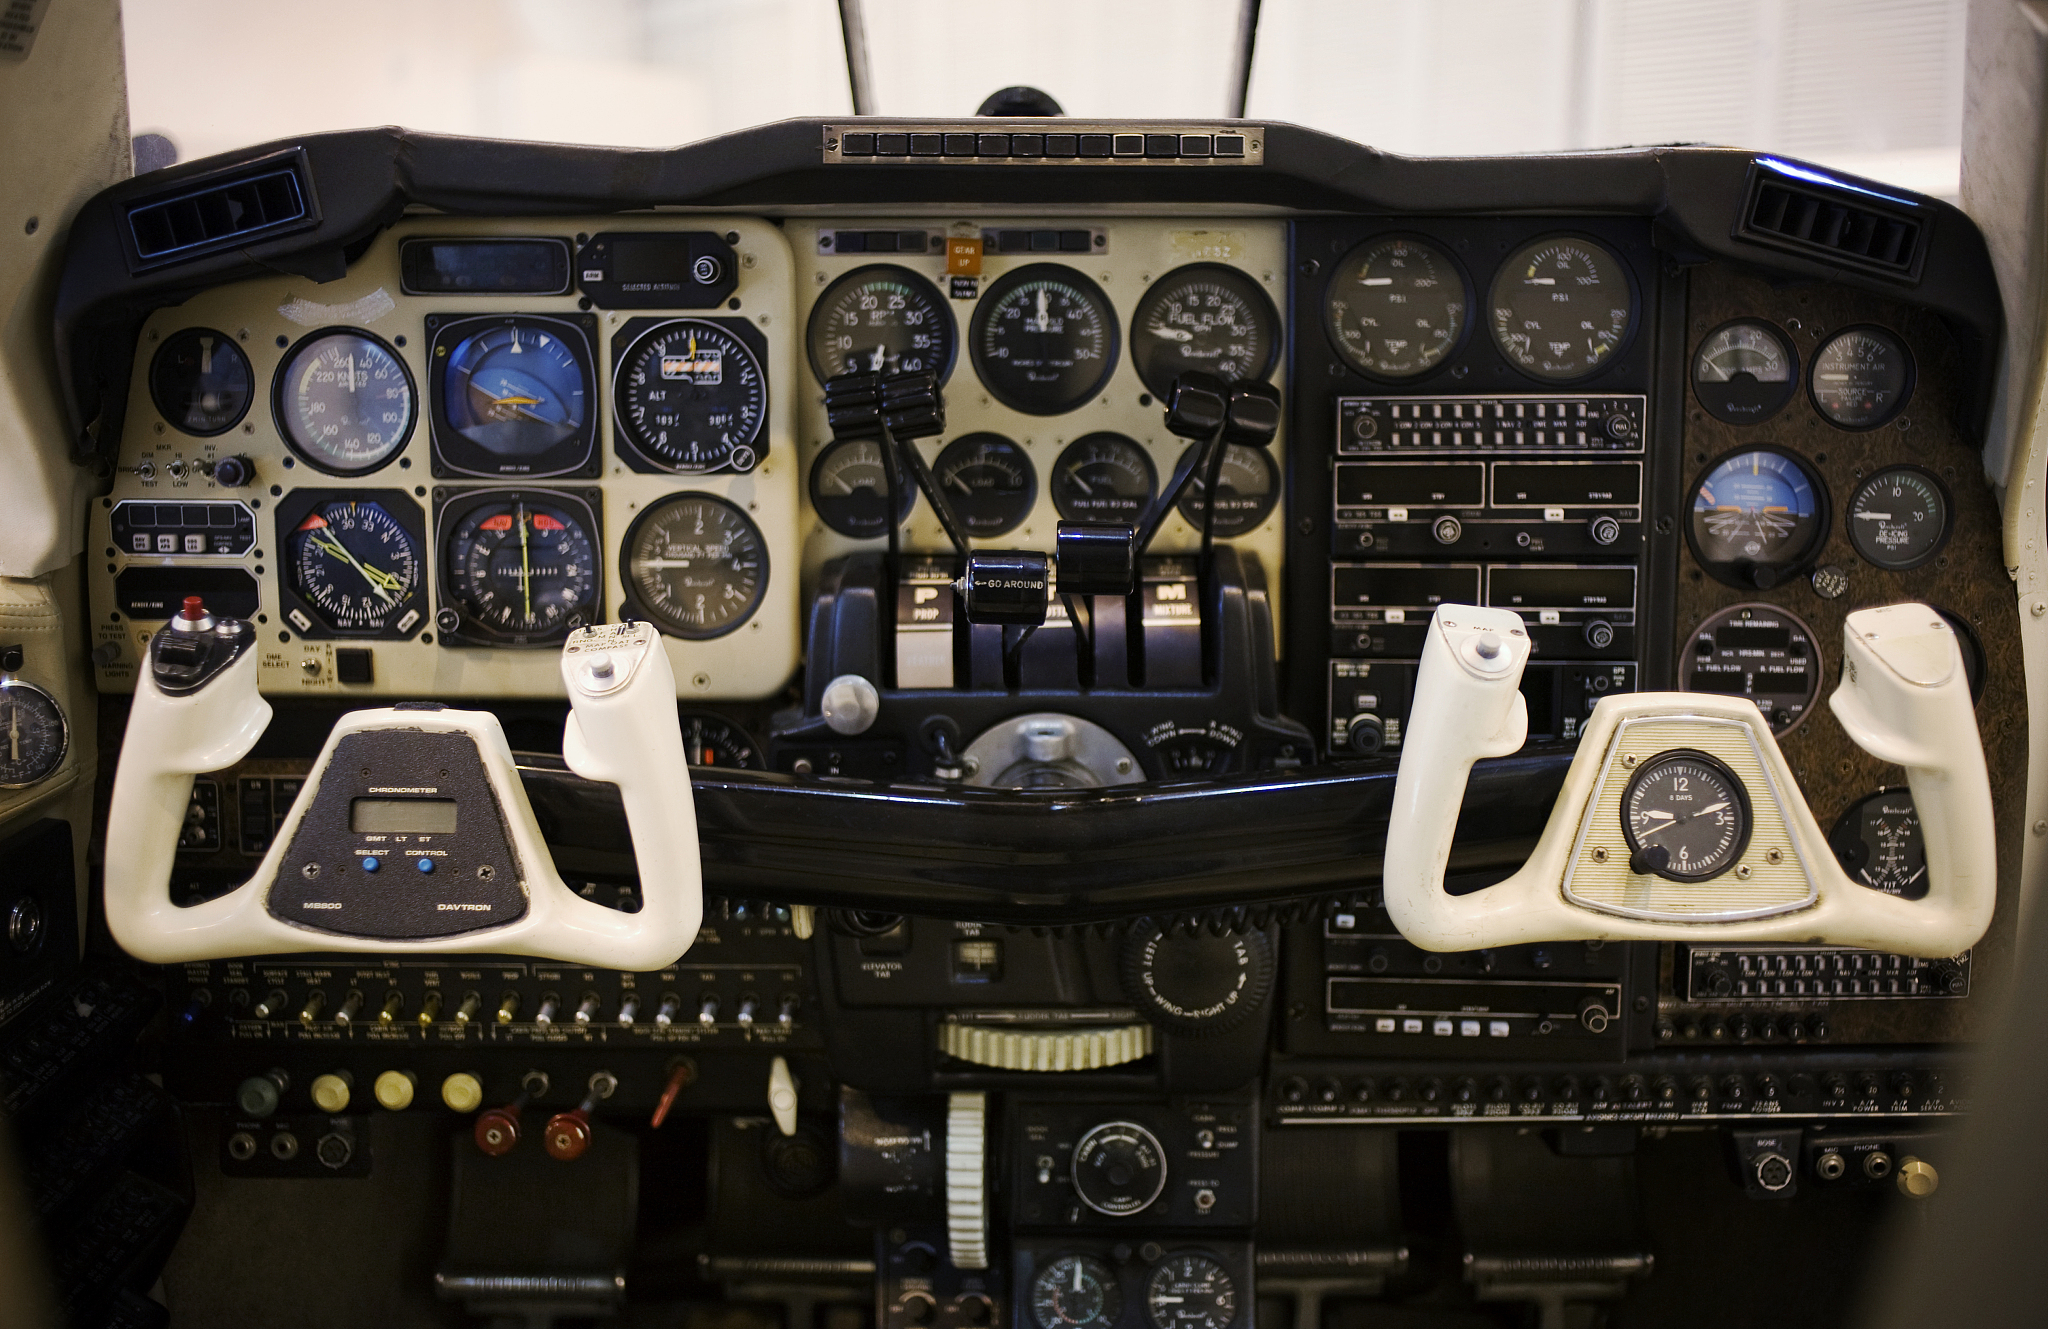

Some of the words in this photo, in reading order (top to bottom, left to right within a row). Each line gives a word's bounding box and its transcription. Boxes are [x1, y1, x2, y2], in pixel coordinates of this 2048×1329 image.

[953, 246, 975, 255] GEAR
[1390, 258, 1405, 268] OIL
[1556, 261, 1571, 269] OIL
[860, 295, 878, 310] 20
[888, 295, 905, 310] 25
[1187, 295, 1200, 307] 15
[1205, 295, 1221, 306] 20
[1551, 293, 1569, 302] PSI
[1005, 307, 1021, 319] 20
[1065, 308, 1083, 320] 40
[1169, 302, 1182, 315] 10
[1219, 304, 1235, 316] 25
[843, 312, 858, 326] 15
[905, 311, 923, 325] 30
[1167, 313, 1198, 326] FUEL
[1203, 315, 1235, 326] FLOW
[1231, 324, 1246, 337] 30
[1524, 321, 1542, 330] CYL
[1581, 320, 1594, 330] OIL
[837, 335, 852, 350] 10
[913, 334, 931, 349] 35
[998, 346, 1009, 359] 10
[360, 358, 372, 369] 40
[902, 358, 922, 372] 40
[1217, 359, 1236, 374] 40
[316, 371, 334, 382] 220
[375, 369, 388, 379] 60
[648, 390, 666, 401] ALT
[1838, 388, 1867, 396] SOURCE
[1876, 392, 1883, 403] R
[383, 412, 397, 423] 100
[323, 425, 338, 435] 160
[1553, 420, 1567, 428] MKR
[1575, 420, 1587, 428] ADF
[1615, 423, 1627, 431] PULL
[345, 438, 360, 449] 140
[367, 433, 381, 444] 120
[1892, 486, 1902, 497] 10
[1913, 511, 1924, 522] 20
[342, 519, 354, 530] 30
[361, 520, 374, 532] 33
[1876, 536, 1910, 545] PRESSURE
[731, 559, 741, 571] 4
[988, 580, 1002, 589] GO
[1004, 580, 1044, 590] AROUND
[914, 587, 939, 604] P
[1156, 583, 1187, 600] M
[915, 608, 939, 620] PROP
[1153, 603, 1193, 616] MIXTURE
[1146, 729, 1176, 748] DOWN
[1208, 729, 1237, 748] DOWN
[1674, 778, 1689, 791] 12
[1641, 812, 1650, 824] 9
[1715, 812, 1724, 825] 3
[1679, 846, 1689, 859] 6
[1141, 941, 1158, 967] LEFT
[1233, 940, 1249, 966] TAB
[874, 971, 891, 979] TAB
[1141, 971, 1154, 986] UP
[1225, 990, 1238, 1005] UP
[1154, 994, 1183, 1017] WING
